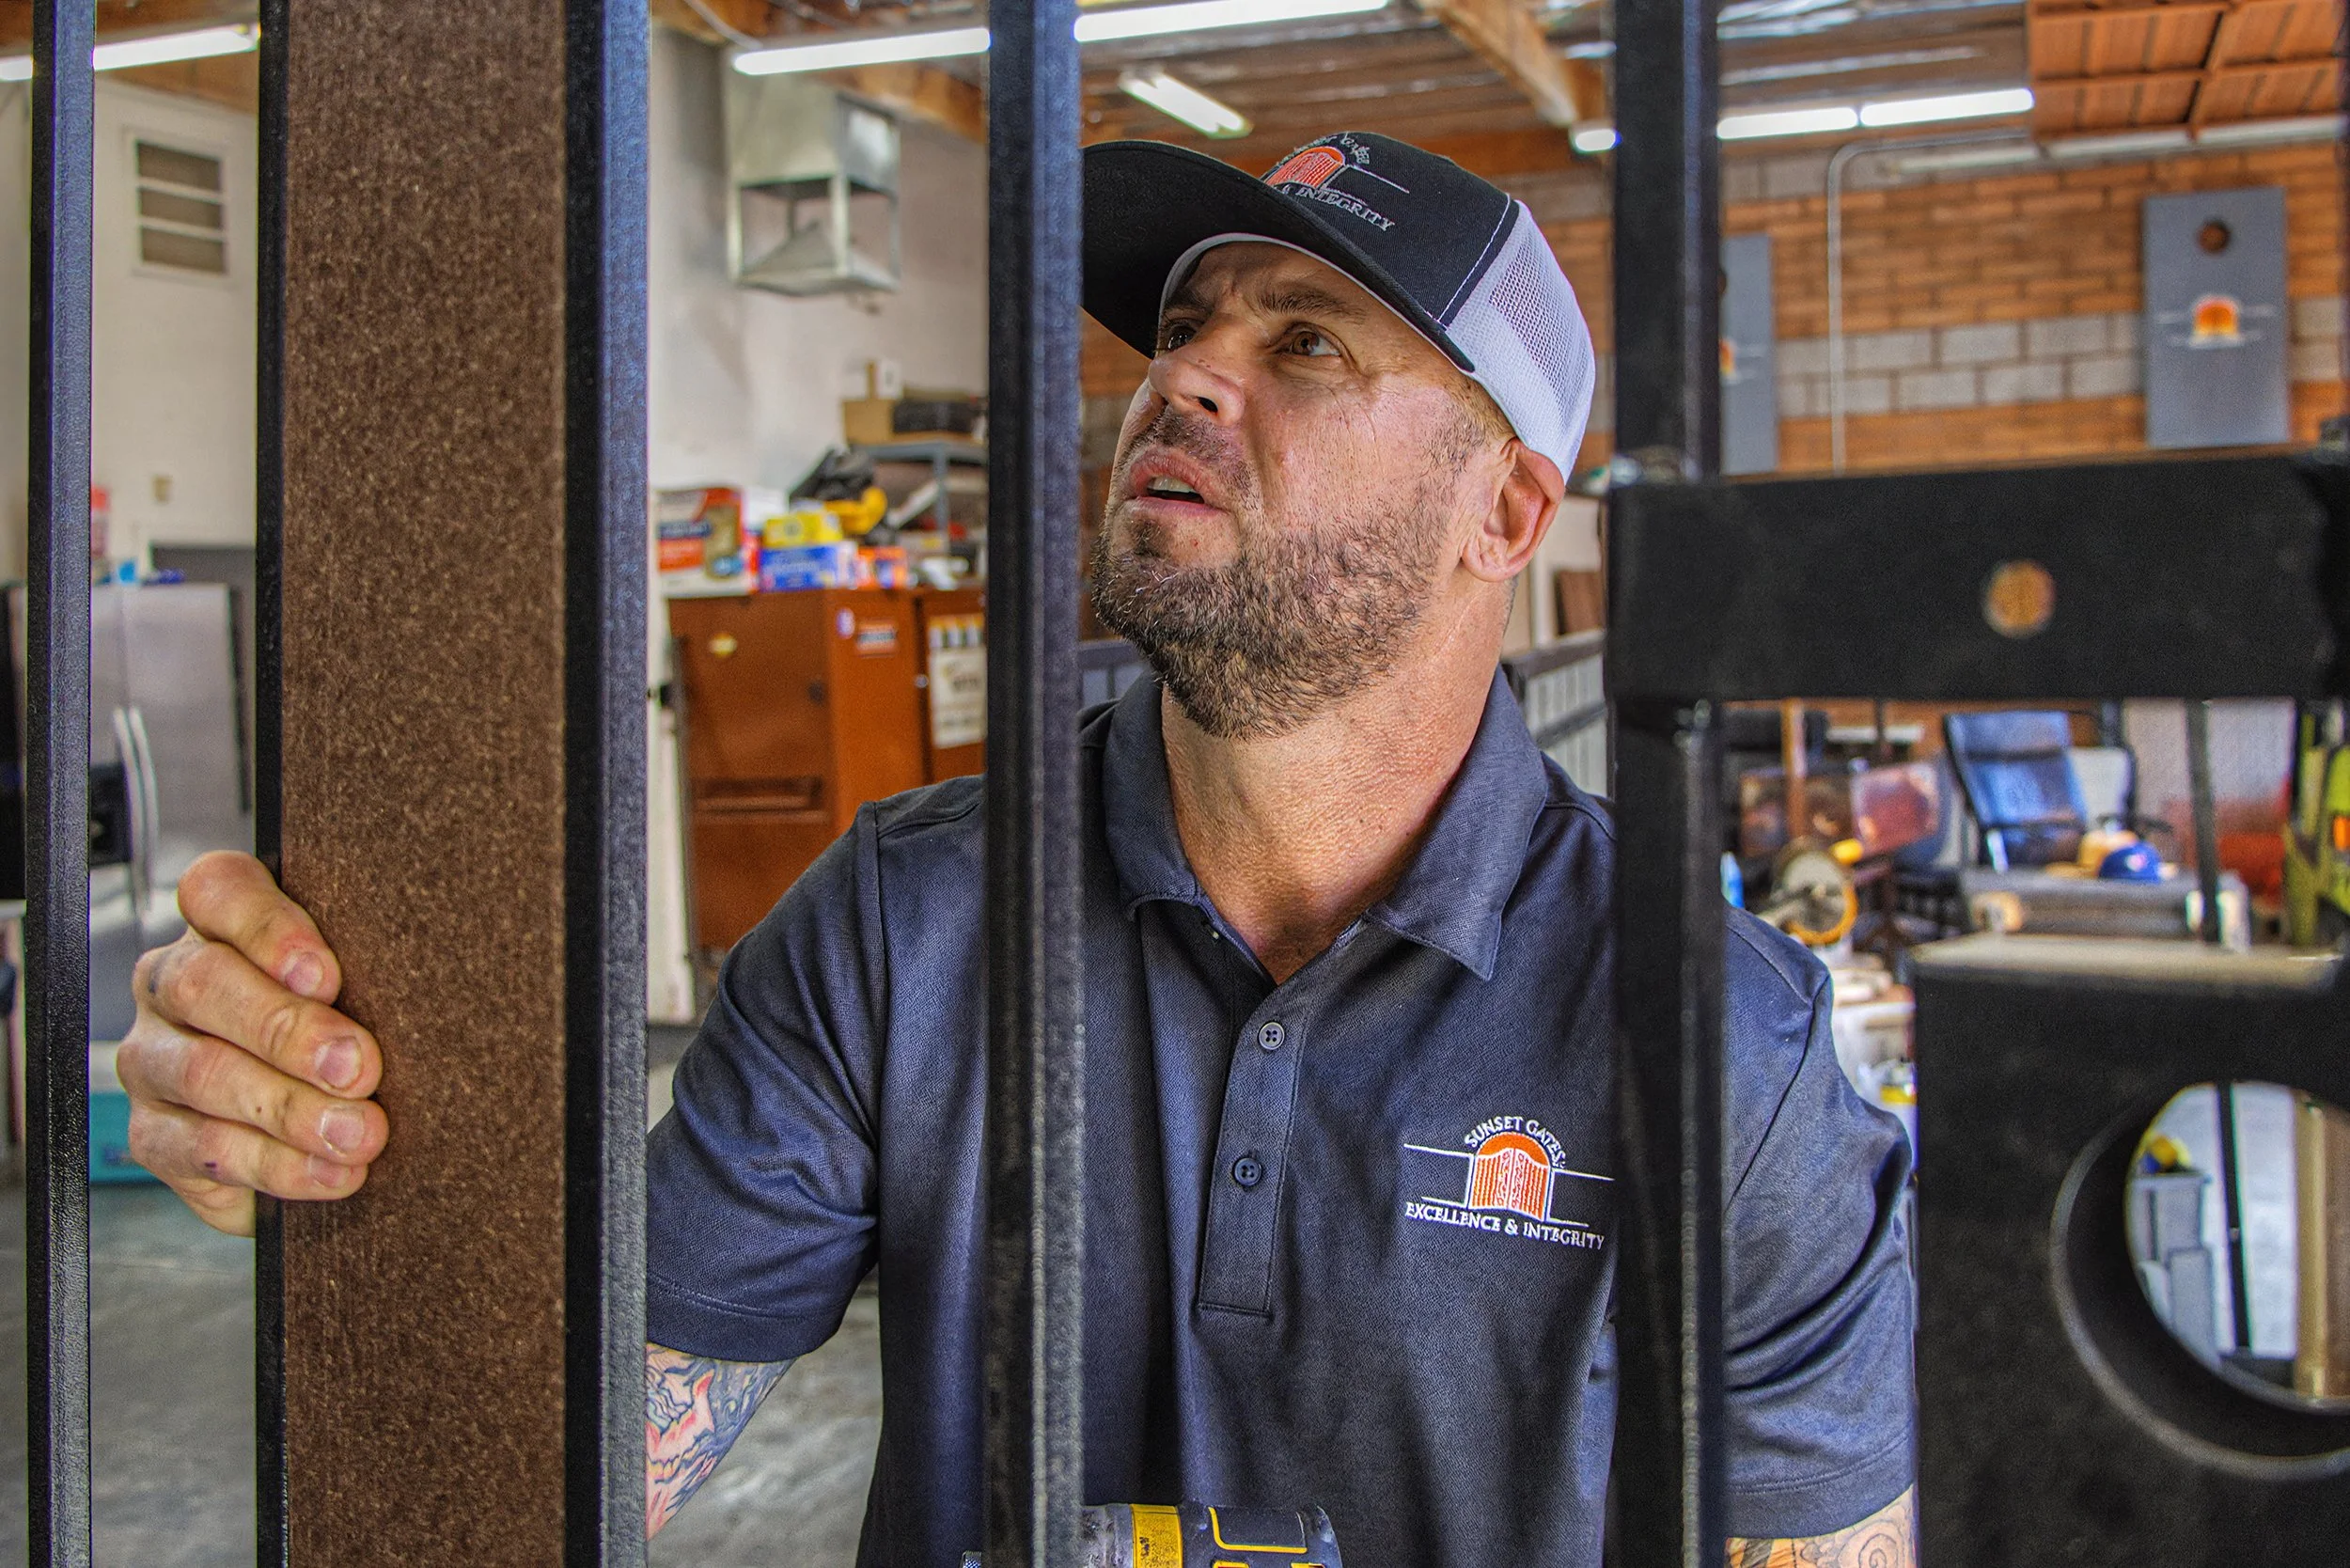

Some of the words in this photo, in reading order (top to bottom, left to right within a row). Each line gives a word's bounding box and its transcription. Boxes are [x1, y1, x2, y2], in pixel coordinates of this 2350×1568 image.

[1295, 186, 1395, 231] INTEGRITY
[1464, 1116, 1524, 1148] SUNSET
[1526, 1119, 1567, 1168] GATES
[1404, 1201, 1501, 1232] EXCELLENCE
[1504, 1217, 1519, 1236] &
[1522, 1221, 1605, 1250] INTEGRITY
